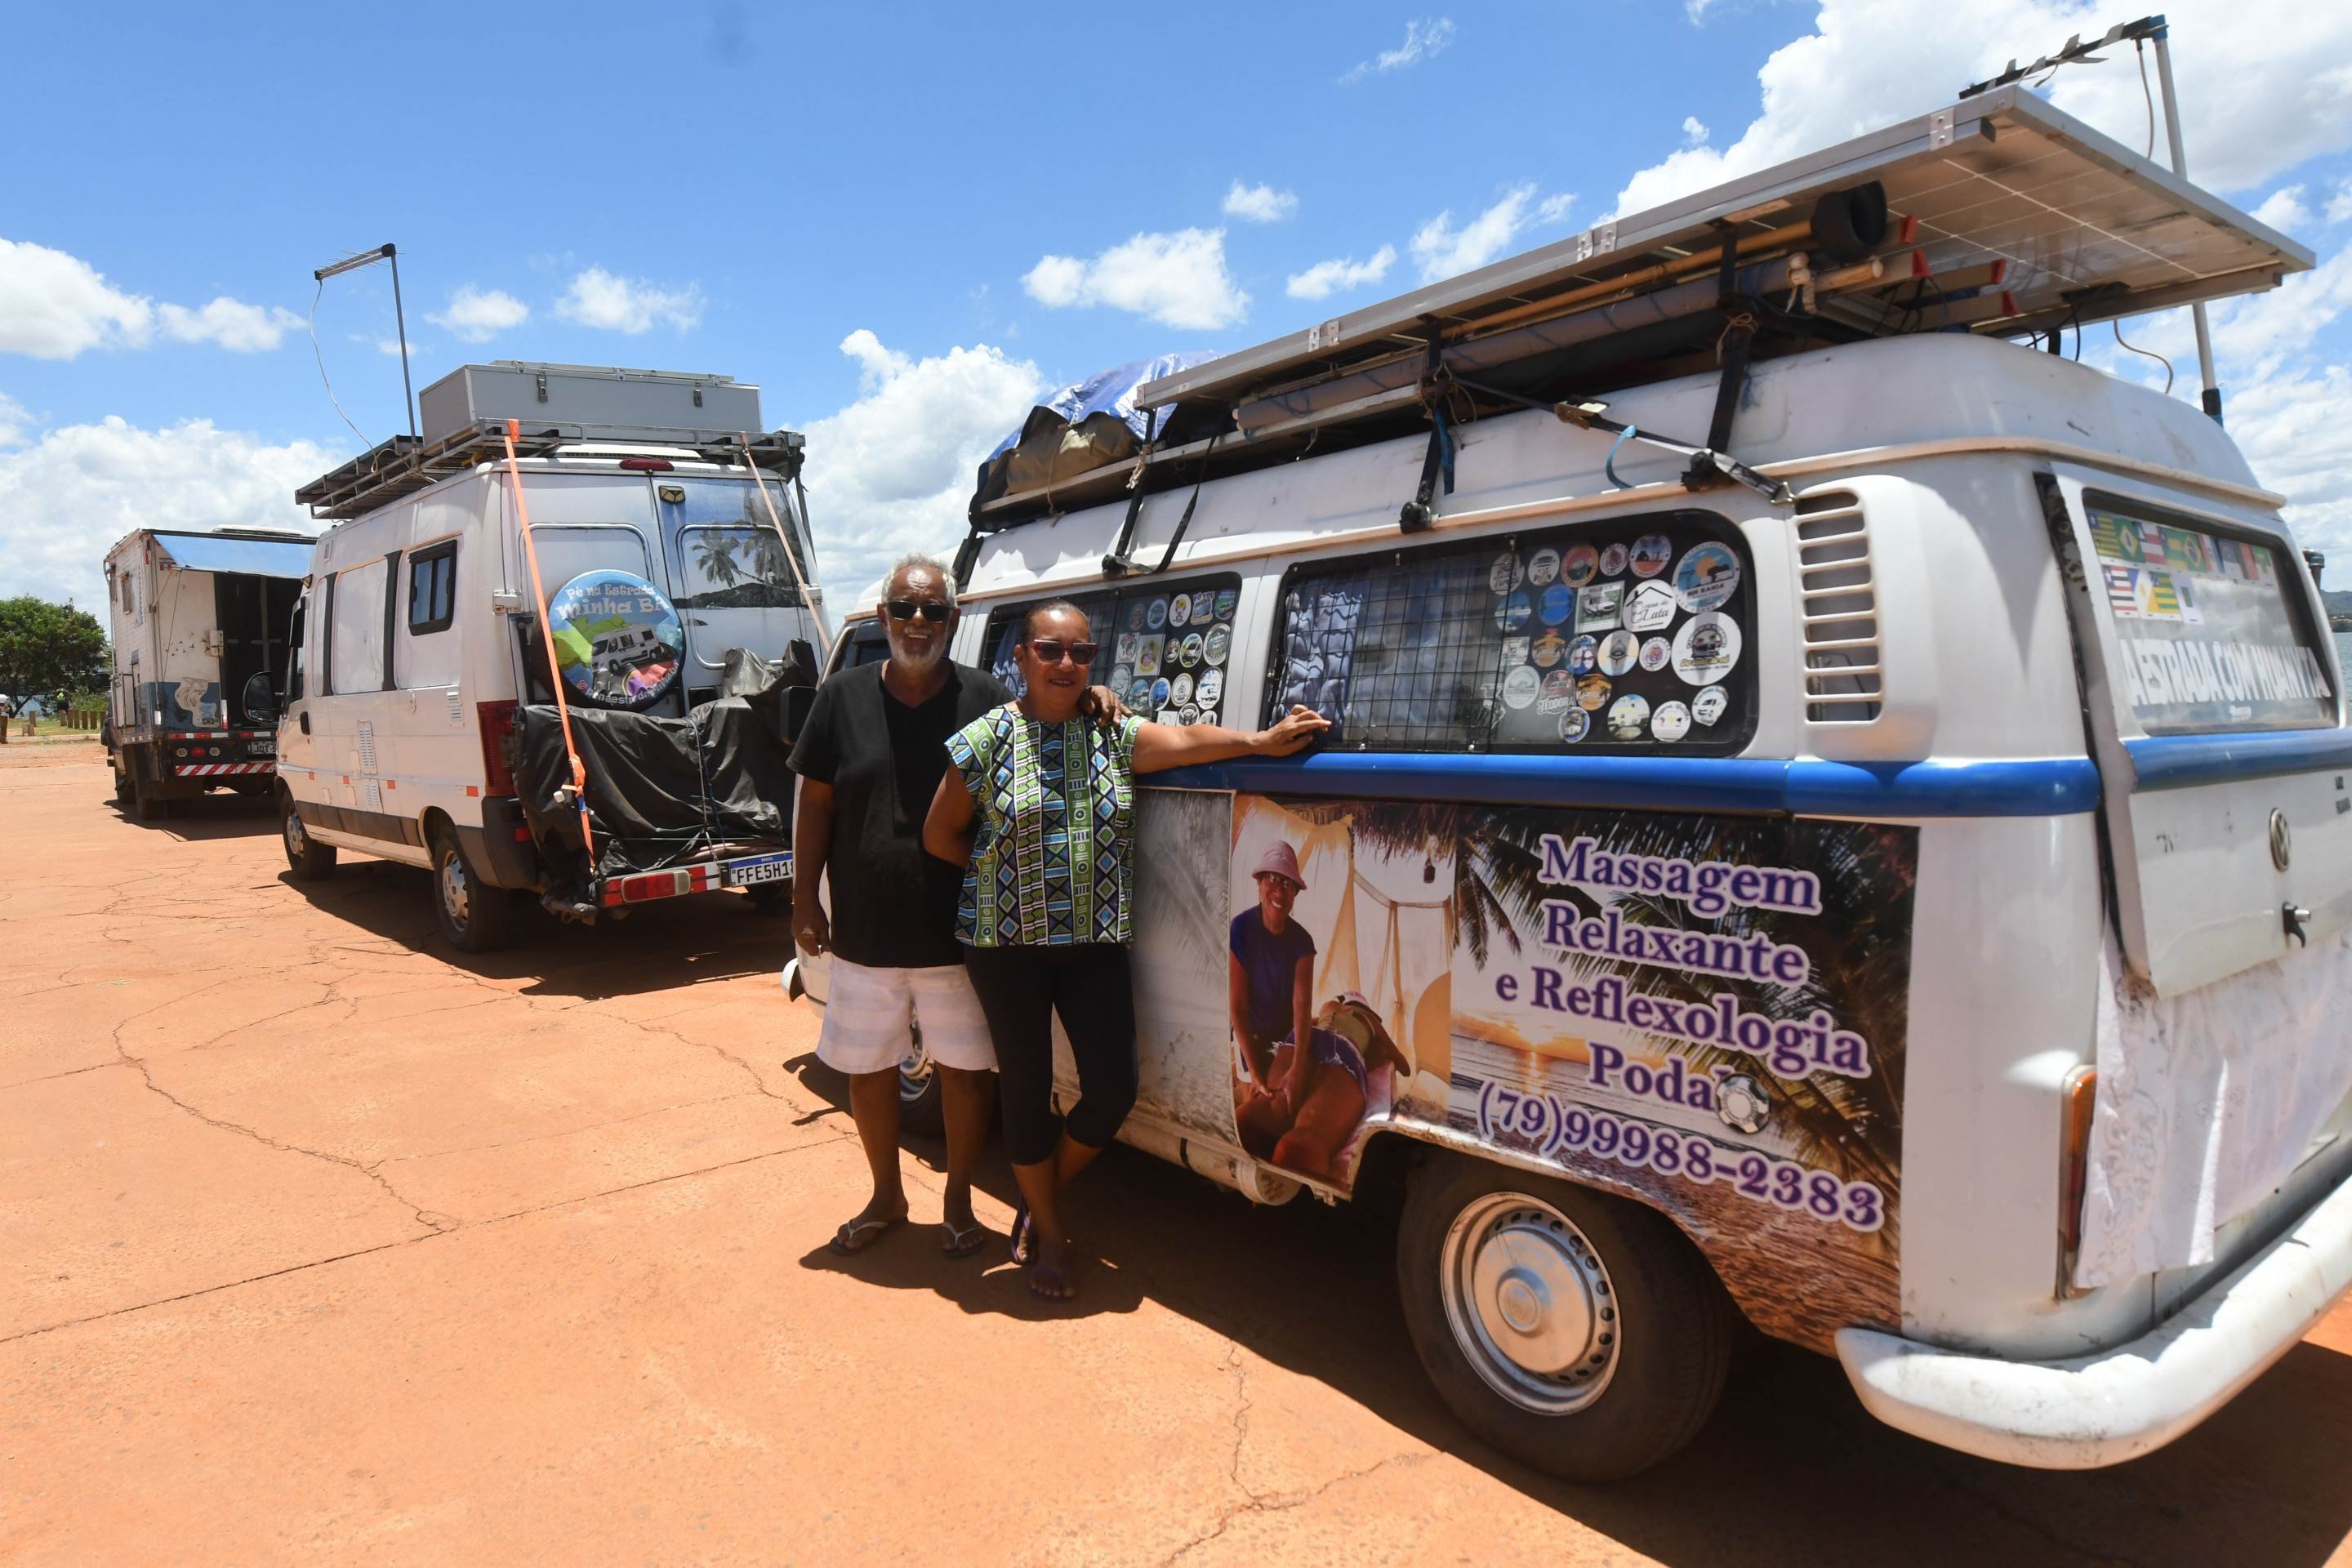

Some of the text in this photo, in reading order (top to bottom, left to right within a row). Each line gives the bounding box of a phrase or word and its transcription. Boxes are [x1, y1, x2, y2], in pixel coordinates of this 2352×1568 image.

[1542, 838, 1818, 912] Massagem
[1544, 904, 1805, 982] Relaxante
[1494, 966, 1869, 1074] e Reflexologia
[1589, 1042, 1731, 1112] Poda
[1479, 1081, 1880, 1227] (79)99988-2383
